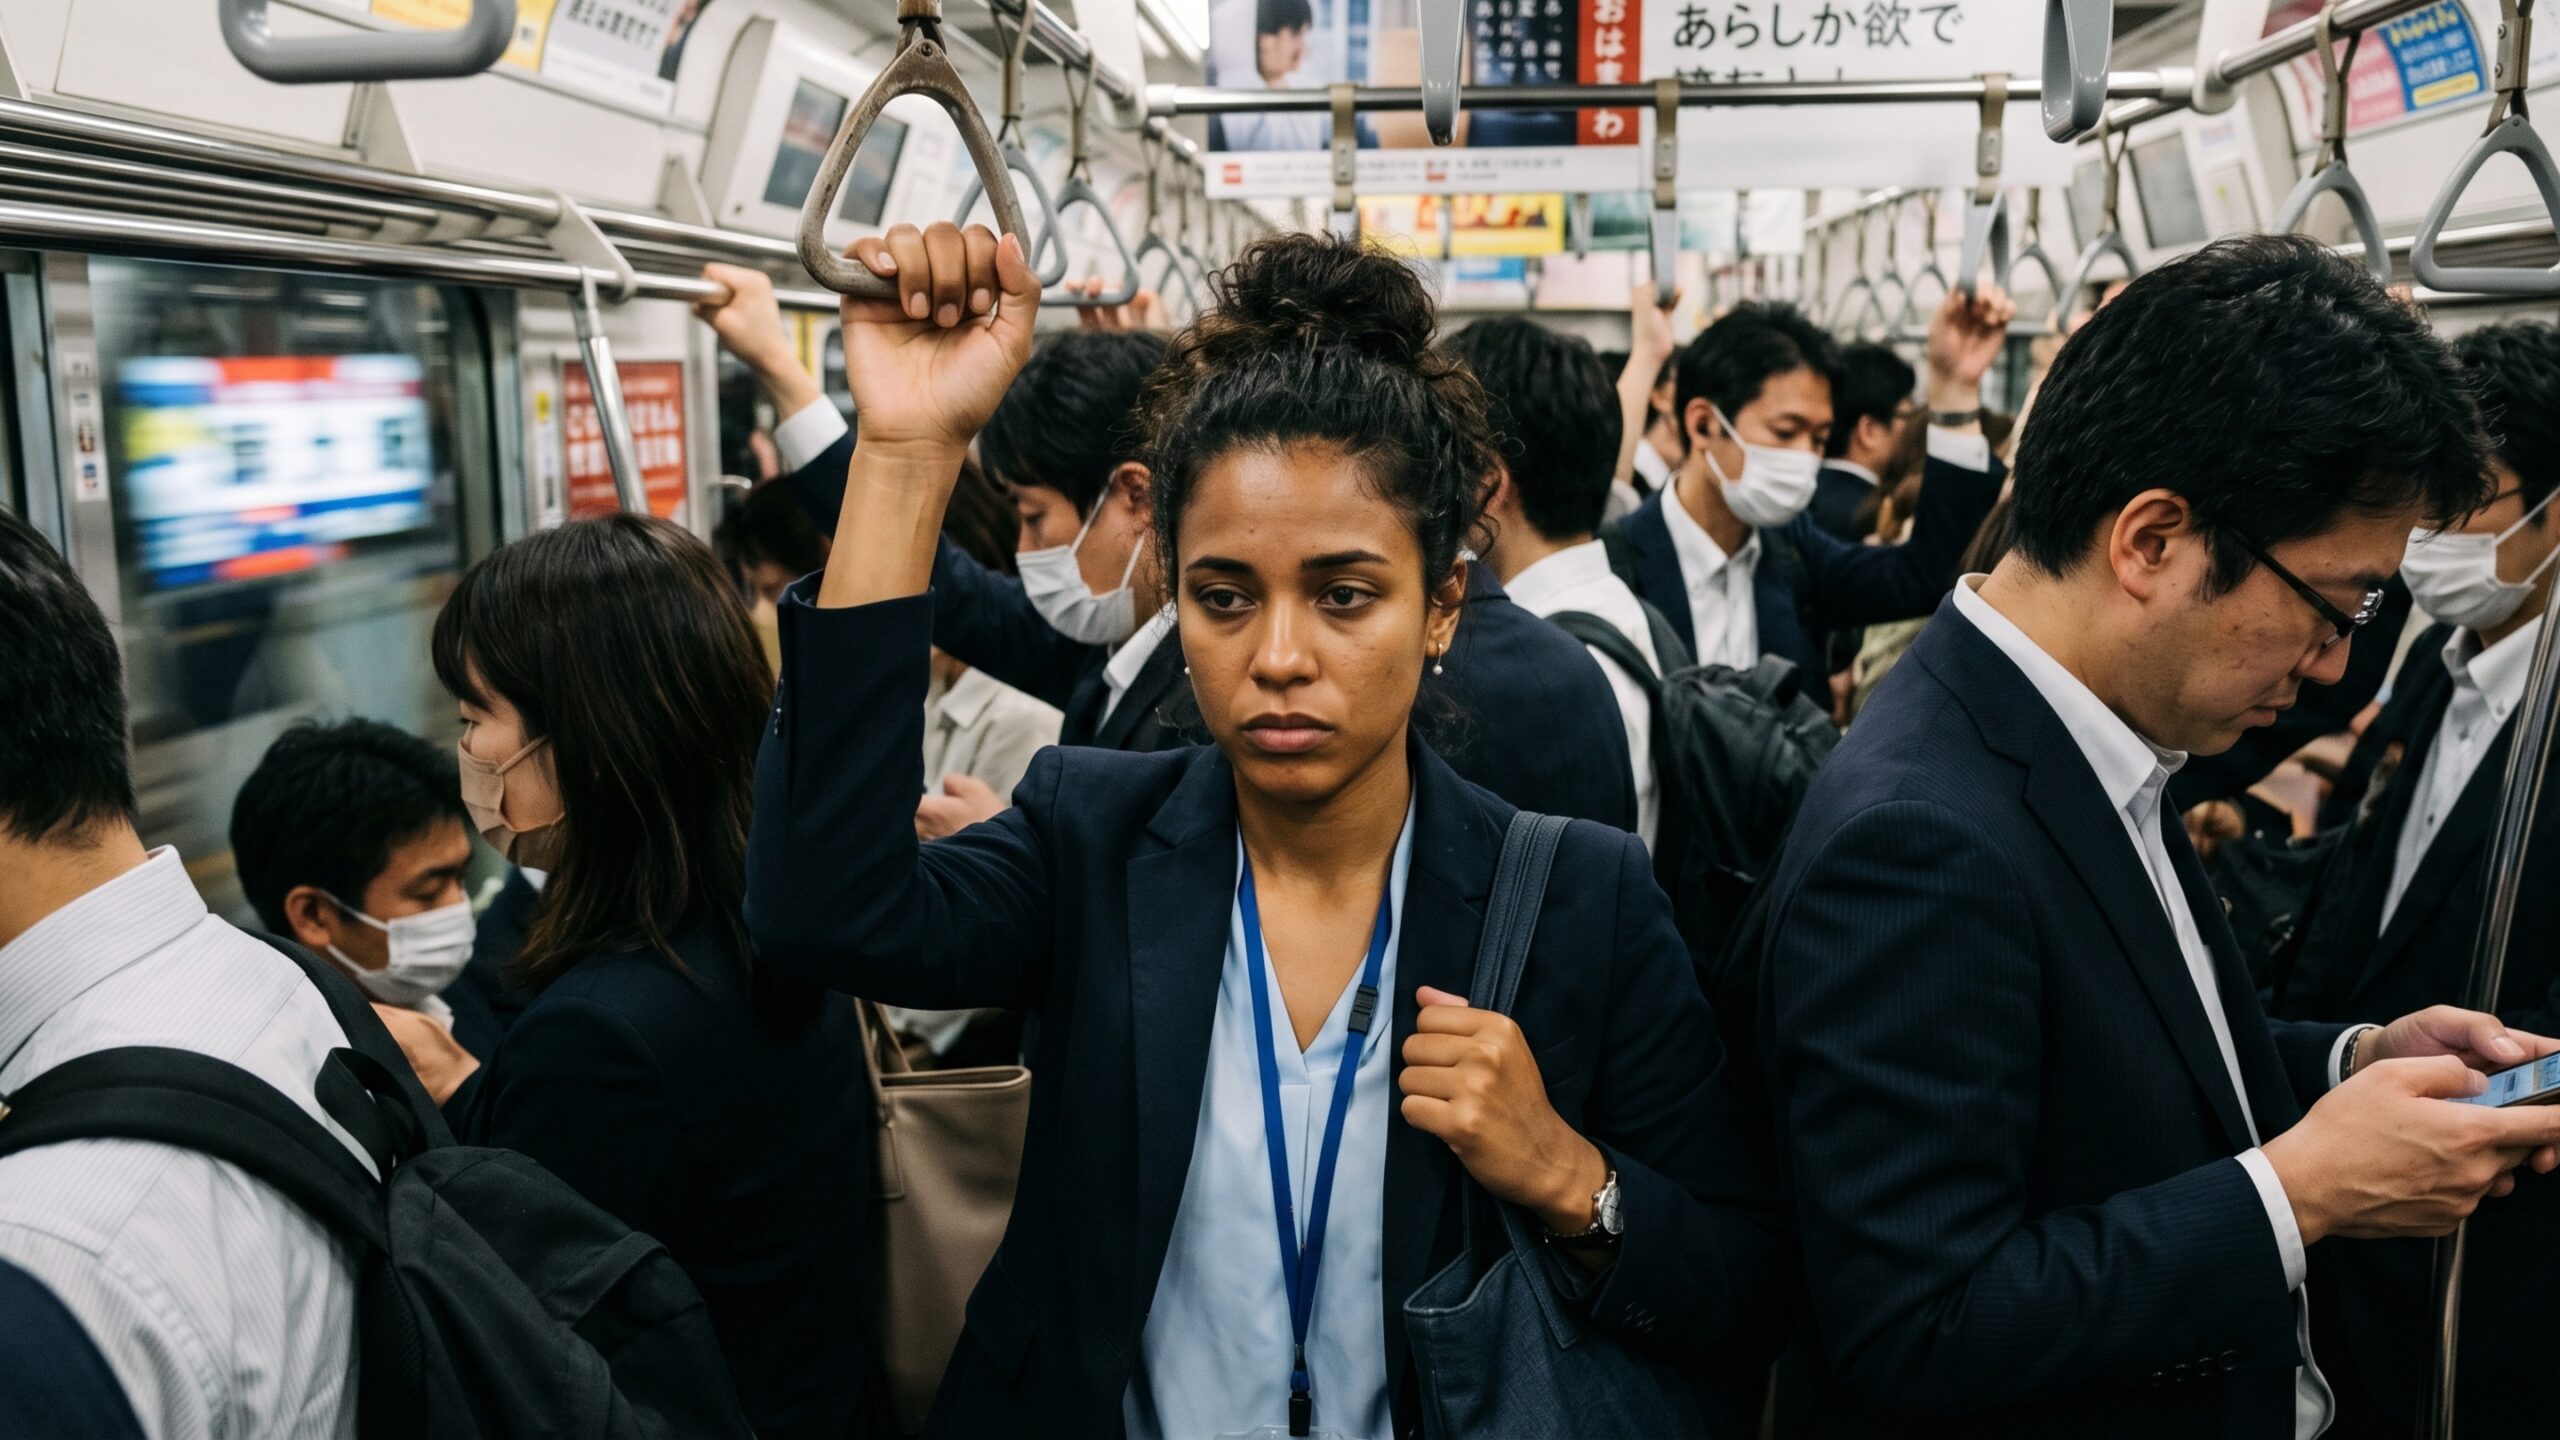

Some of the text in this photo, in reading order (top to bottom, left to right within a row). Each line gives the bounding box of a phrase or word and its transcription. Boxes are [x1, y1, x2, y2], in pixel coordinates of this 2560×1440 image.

[1673, 0, 1964, 50] あらしか欲で
